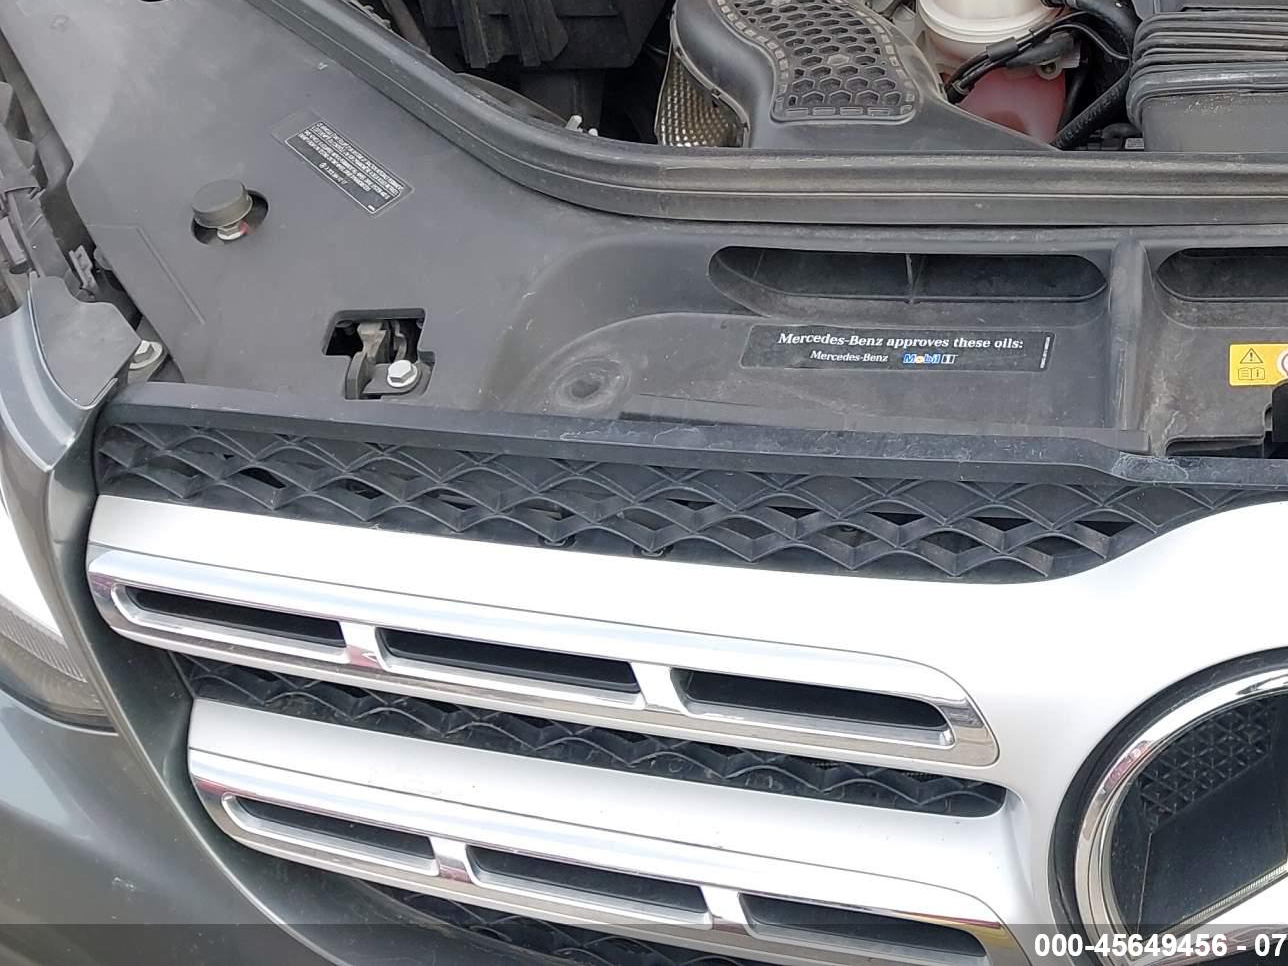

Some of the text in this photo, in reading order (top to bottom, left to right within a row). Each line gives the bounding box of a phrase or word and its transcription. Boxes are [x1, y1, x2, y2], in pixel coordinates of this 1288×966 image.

[778, 333, 1024, 350] Mercedes-Benz approves these oils:
[810, 350, 889, 363] Mercedes-Benz
[902, 353, 941, 364] Mobil
